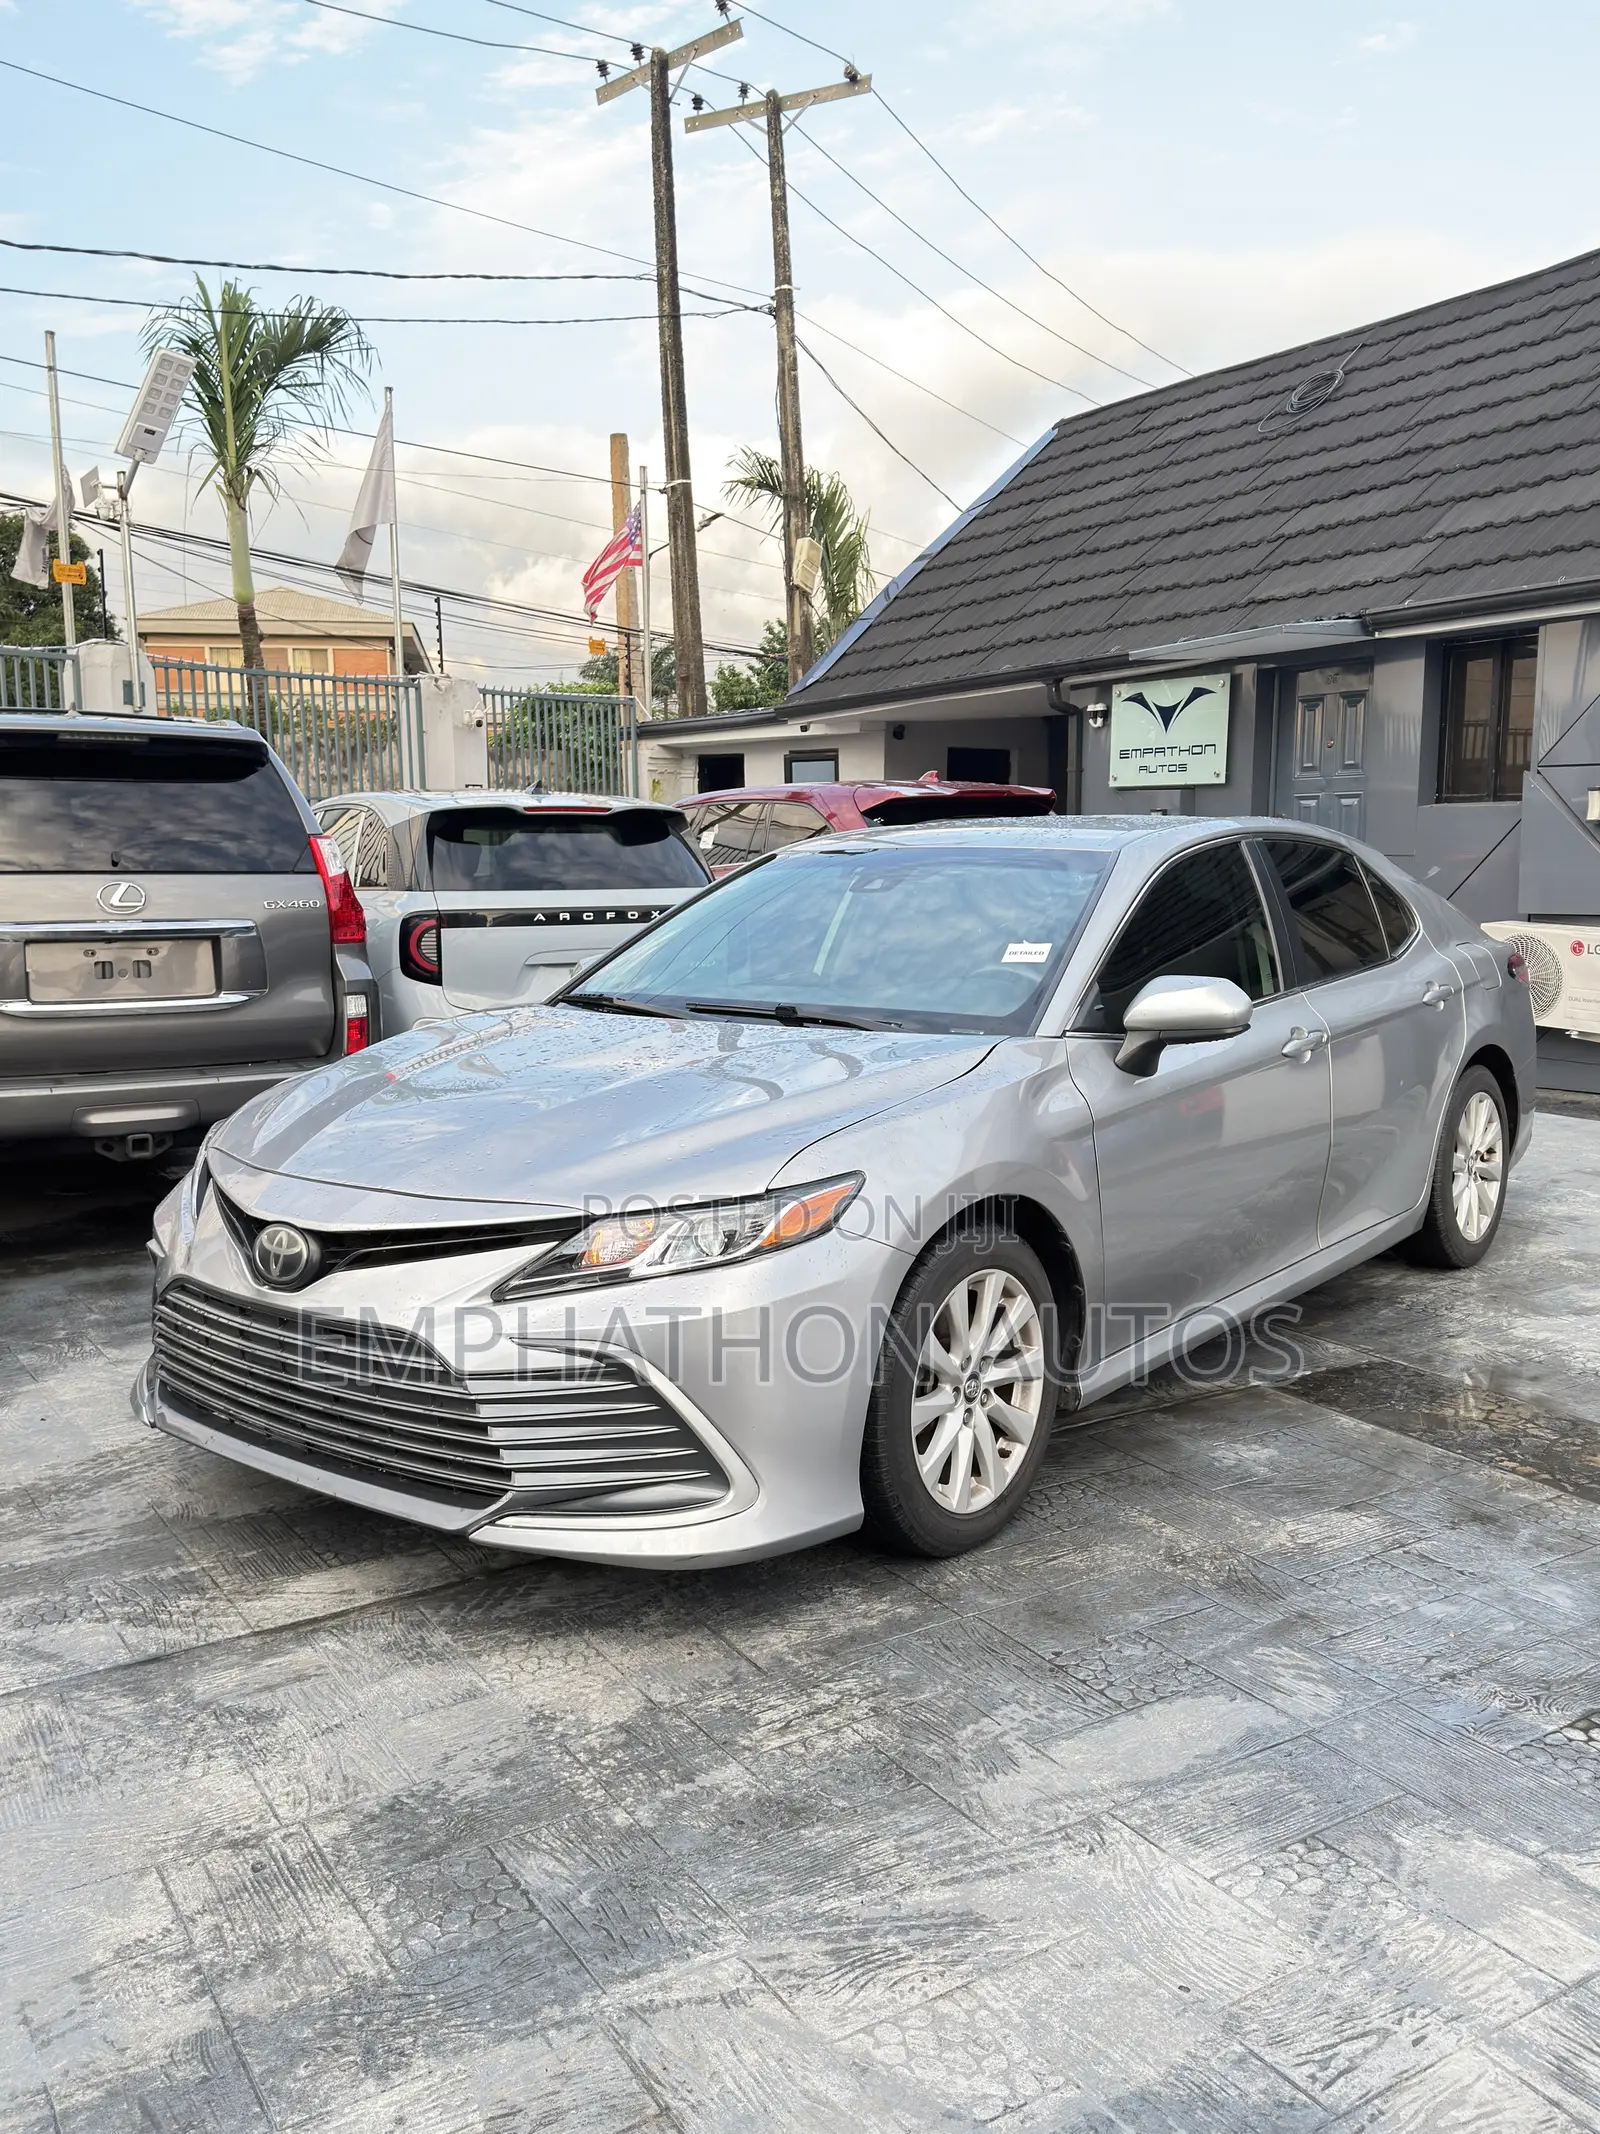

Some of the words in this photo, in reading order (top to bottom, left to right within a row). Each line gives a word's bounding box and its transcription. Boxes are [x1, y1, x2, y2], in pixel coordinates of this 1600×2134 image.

[1119, 744, 1217, 760] EMPATHON
[1138, 763, 1188, 774] AUTOS
[263, 900, 320, 909] GX460
[533, 910, 661, 921] ARCFOX
